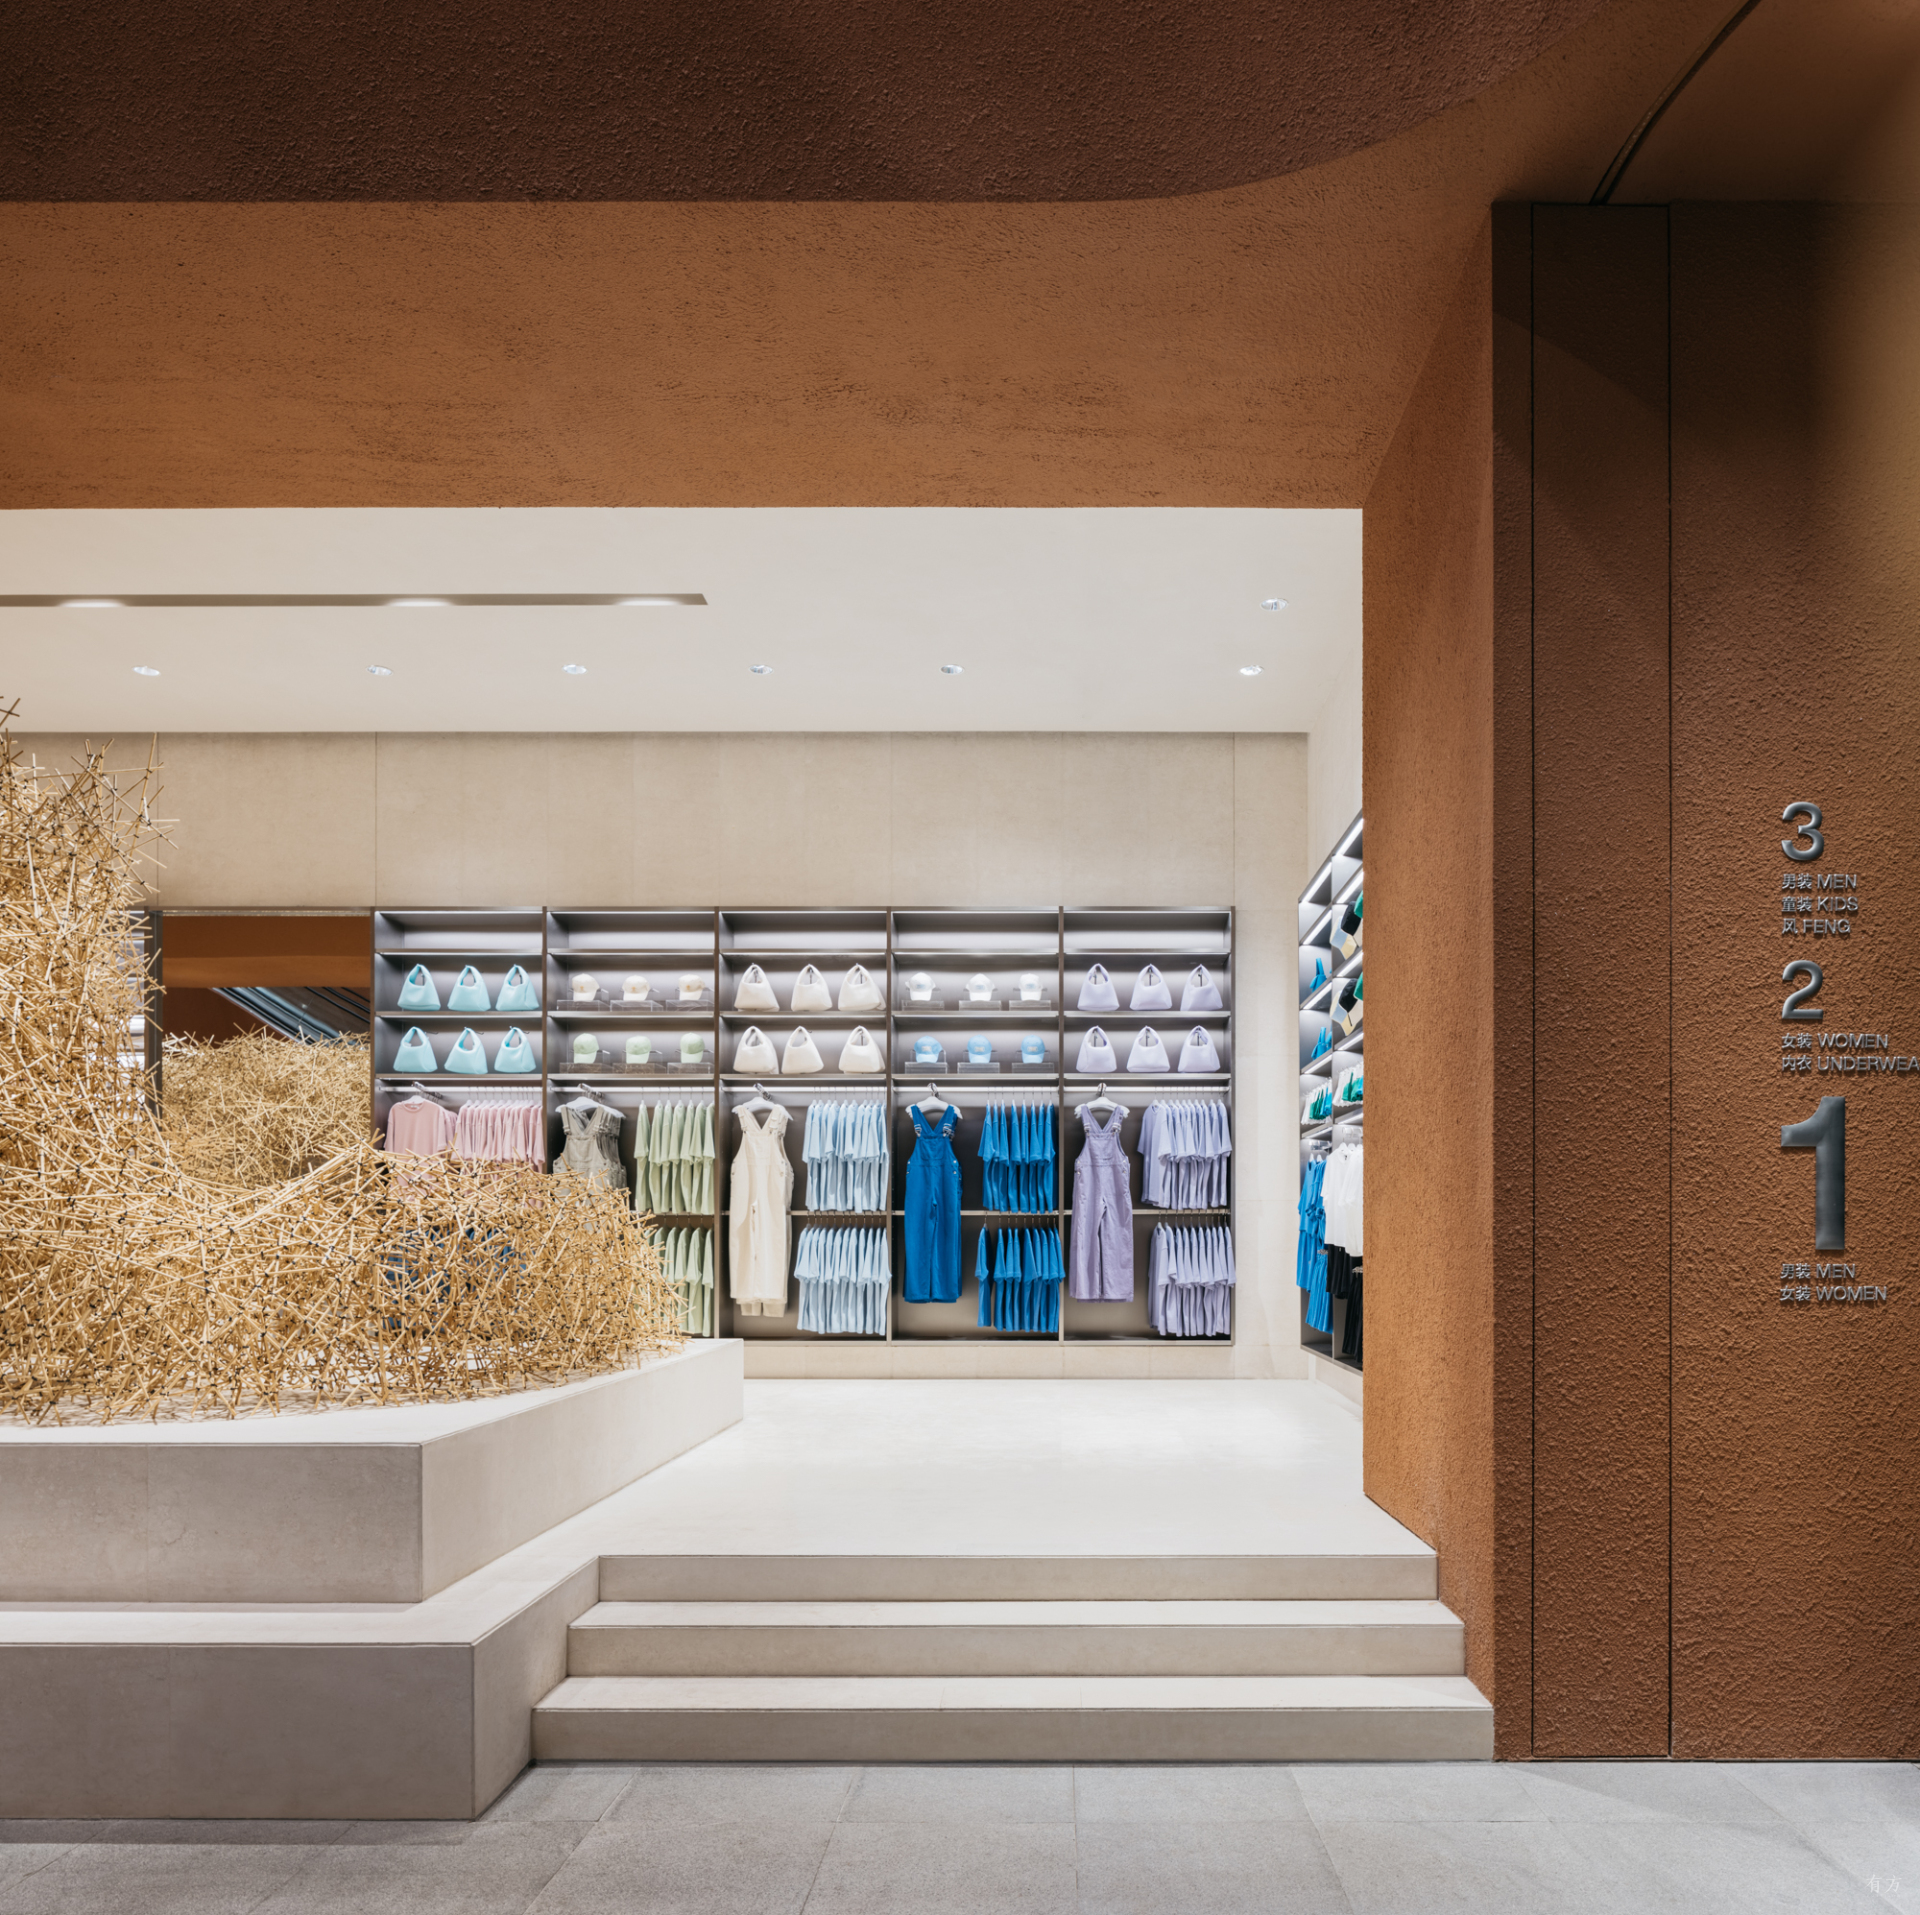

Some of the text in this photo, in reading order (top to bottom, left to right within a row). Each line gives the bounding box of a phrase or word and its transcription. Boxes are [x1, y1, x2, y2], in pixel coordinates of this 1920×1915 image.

[1781, 801, 1825, 861] 3
[1782, 873, 1858, 890] 男装 MEN
[1781, 896, 1859, 913] 童装 KIDS
[1781, 918, 1851, 935] 风 FENG
[1781, 960, 1824, 1020] 2
[1781, 1033, 1889, 1049] 女装 WOMEN
[1781, 1055, 1812, 1071] 内衣
[1781, 1096, 1846, 1250] 1
[1780, 1263, 1856, 1279] 男装 MEN
[1780, 1286, 1887, 1301] 女装 WOMEN
